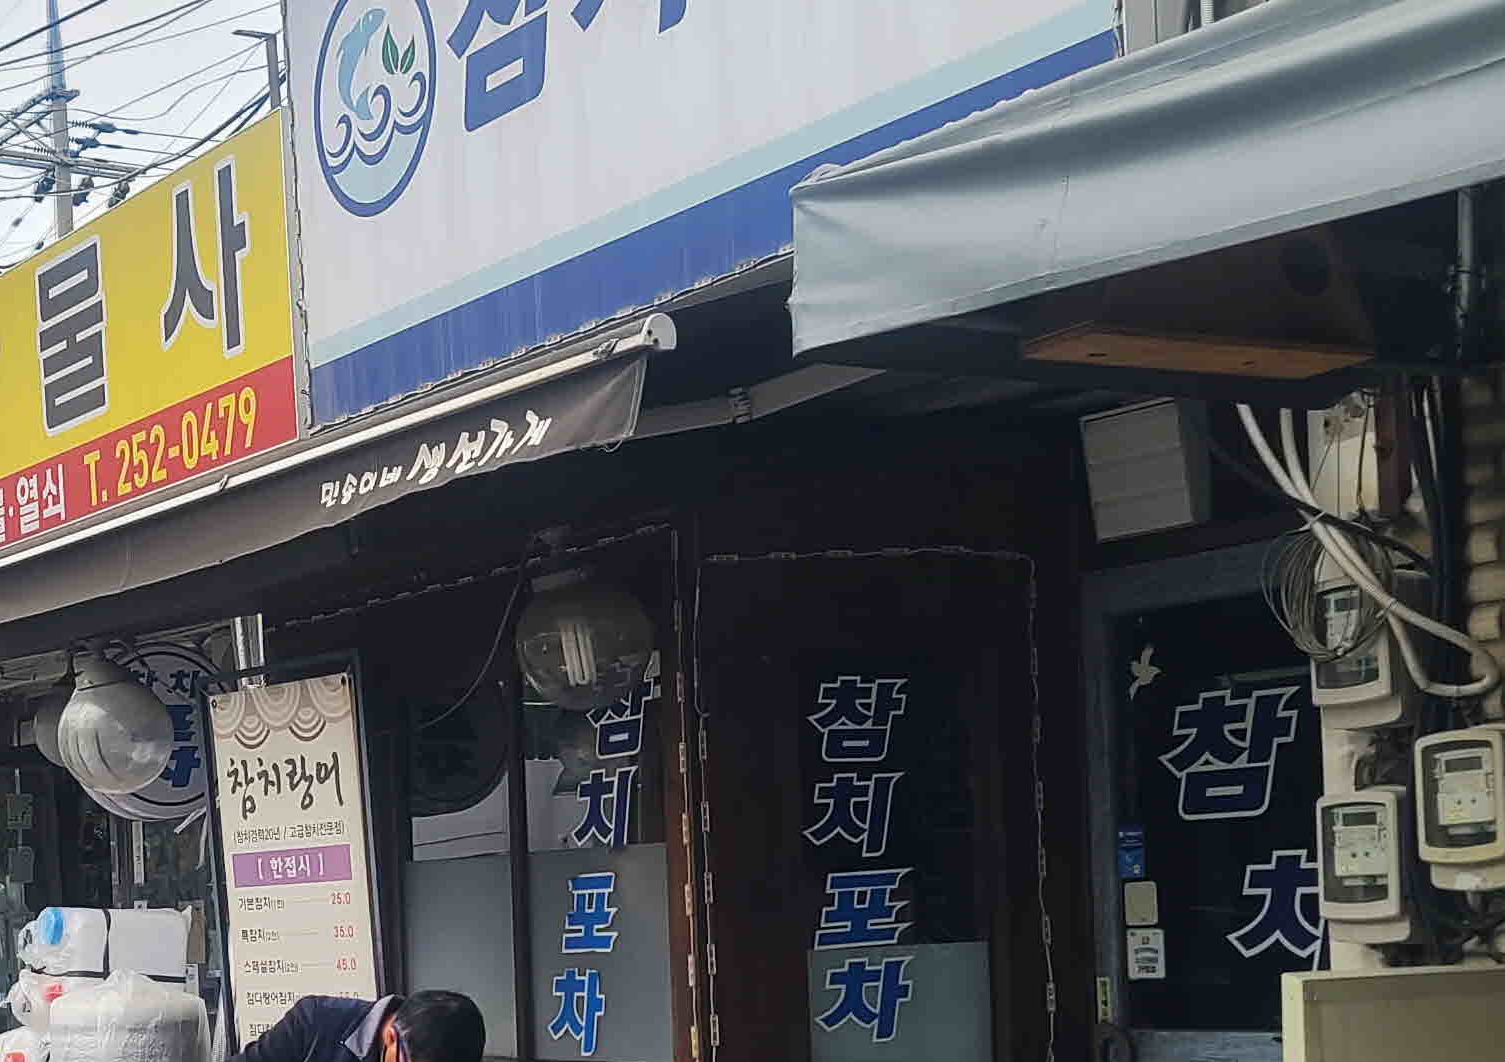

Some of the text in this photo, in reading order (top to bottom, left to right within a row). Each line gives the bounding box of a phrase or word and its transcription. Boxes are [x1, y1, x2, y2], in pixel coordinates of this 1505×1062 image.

[83, 450, 108, 507] T.
[115, 386, 257, 498] 252-0479
[406, 410, 553, 485] 생선가게
[803, 675, 915, 1042] 참치포차
